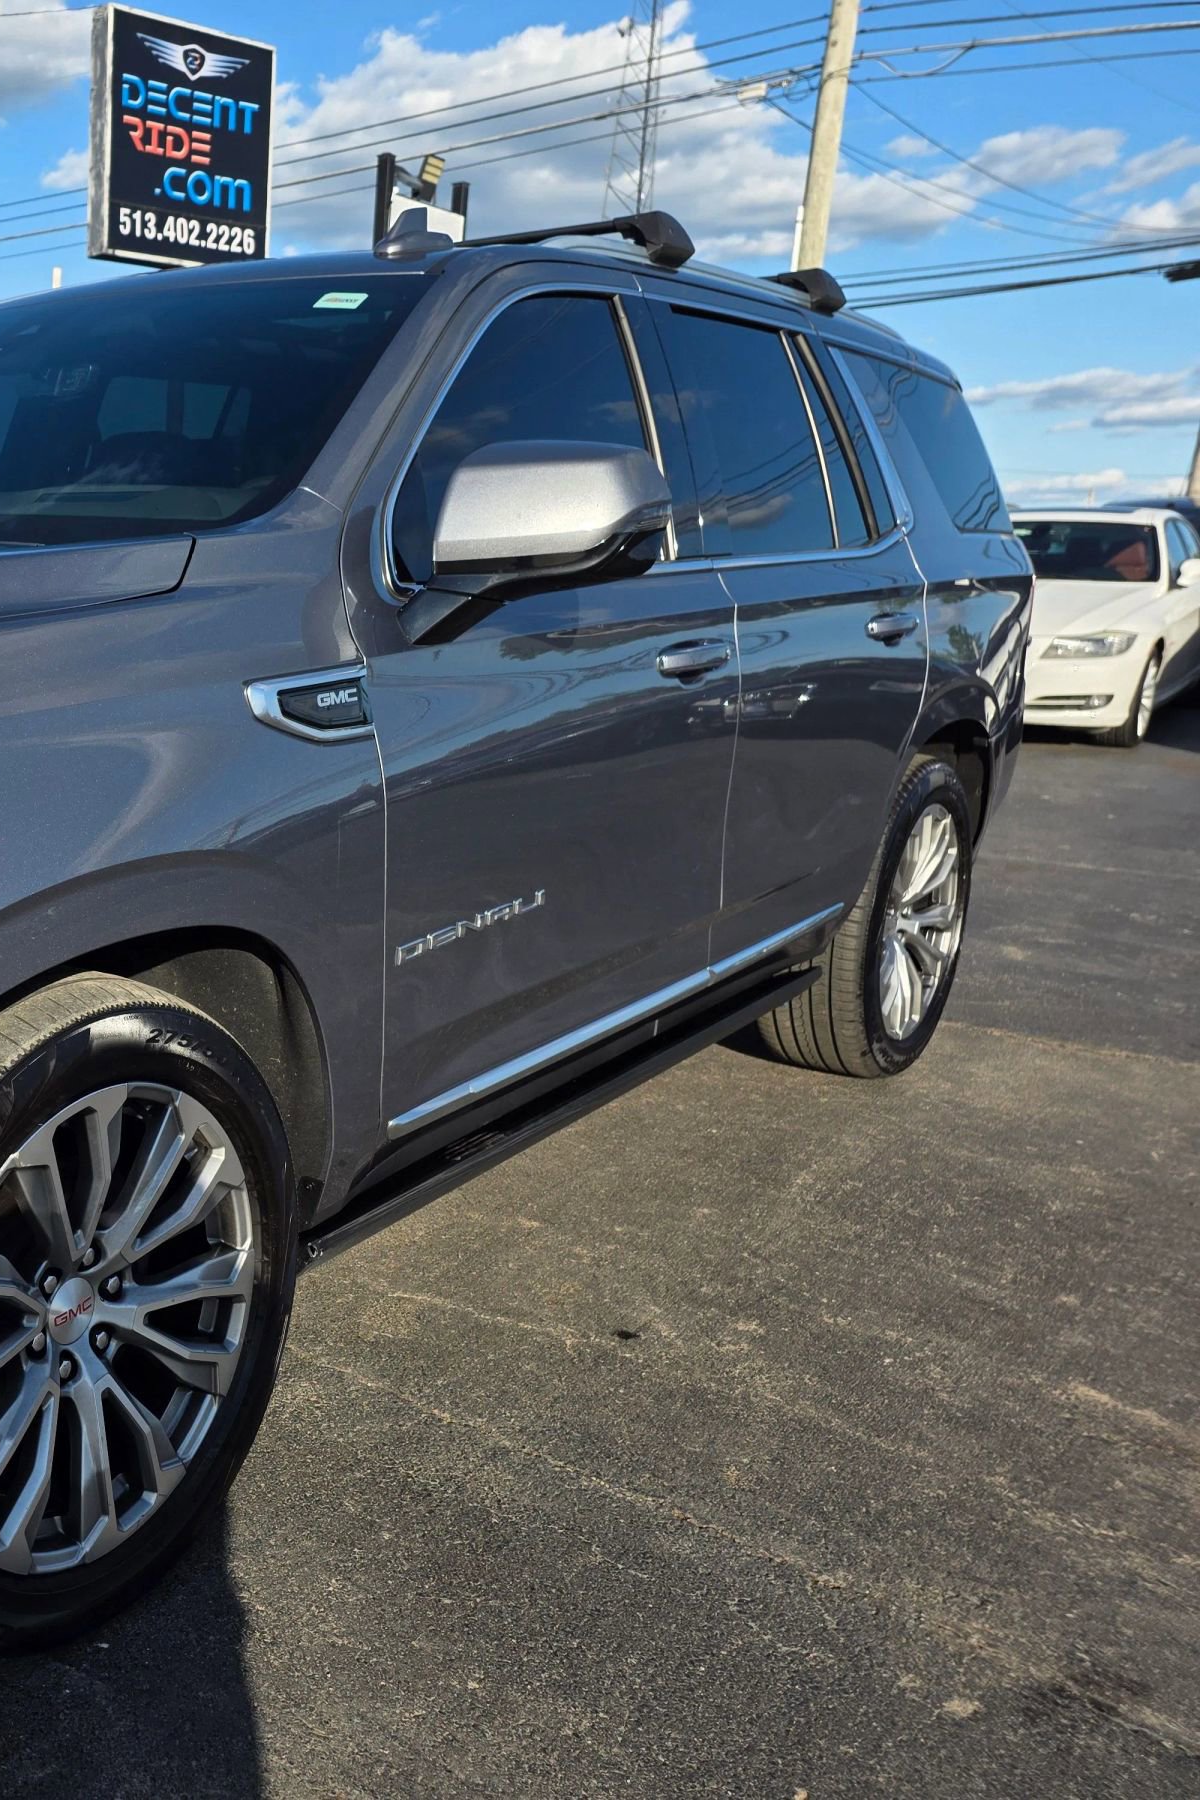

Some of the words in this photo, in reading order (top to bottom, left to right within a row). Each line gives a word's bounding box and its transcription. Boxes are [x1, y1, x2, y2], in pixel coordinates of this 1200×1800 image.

[122, 115, 212, 166] RIDE
[119, 206, 256, 255] 513.402.2226
[316, 687, 358, 708] GMC
[394, 888, 546, 968] DENALI
[53, 1295, 92, 1327] GMC
